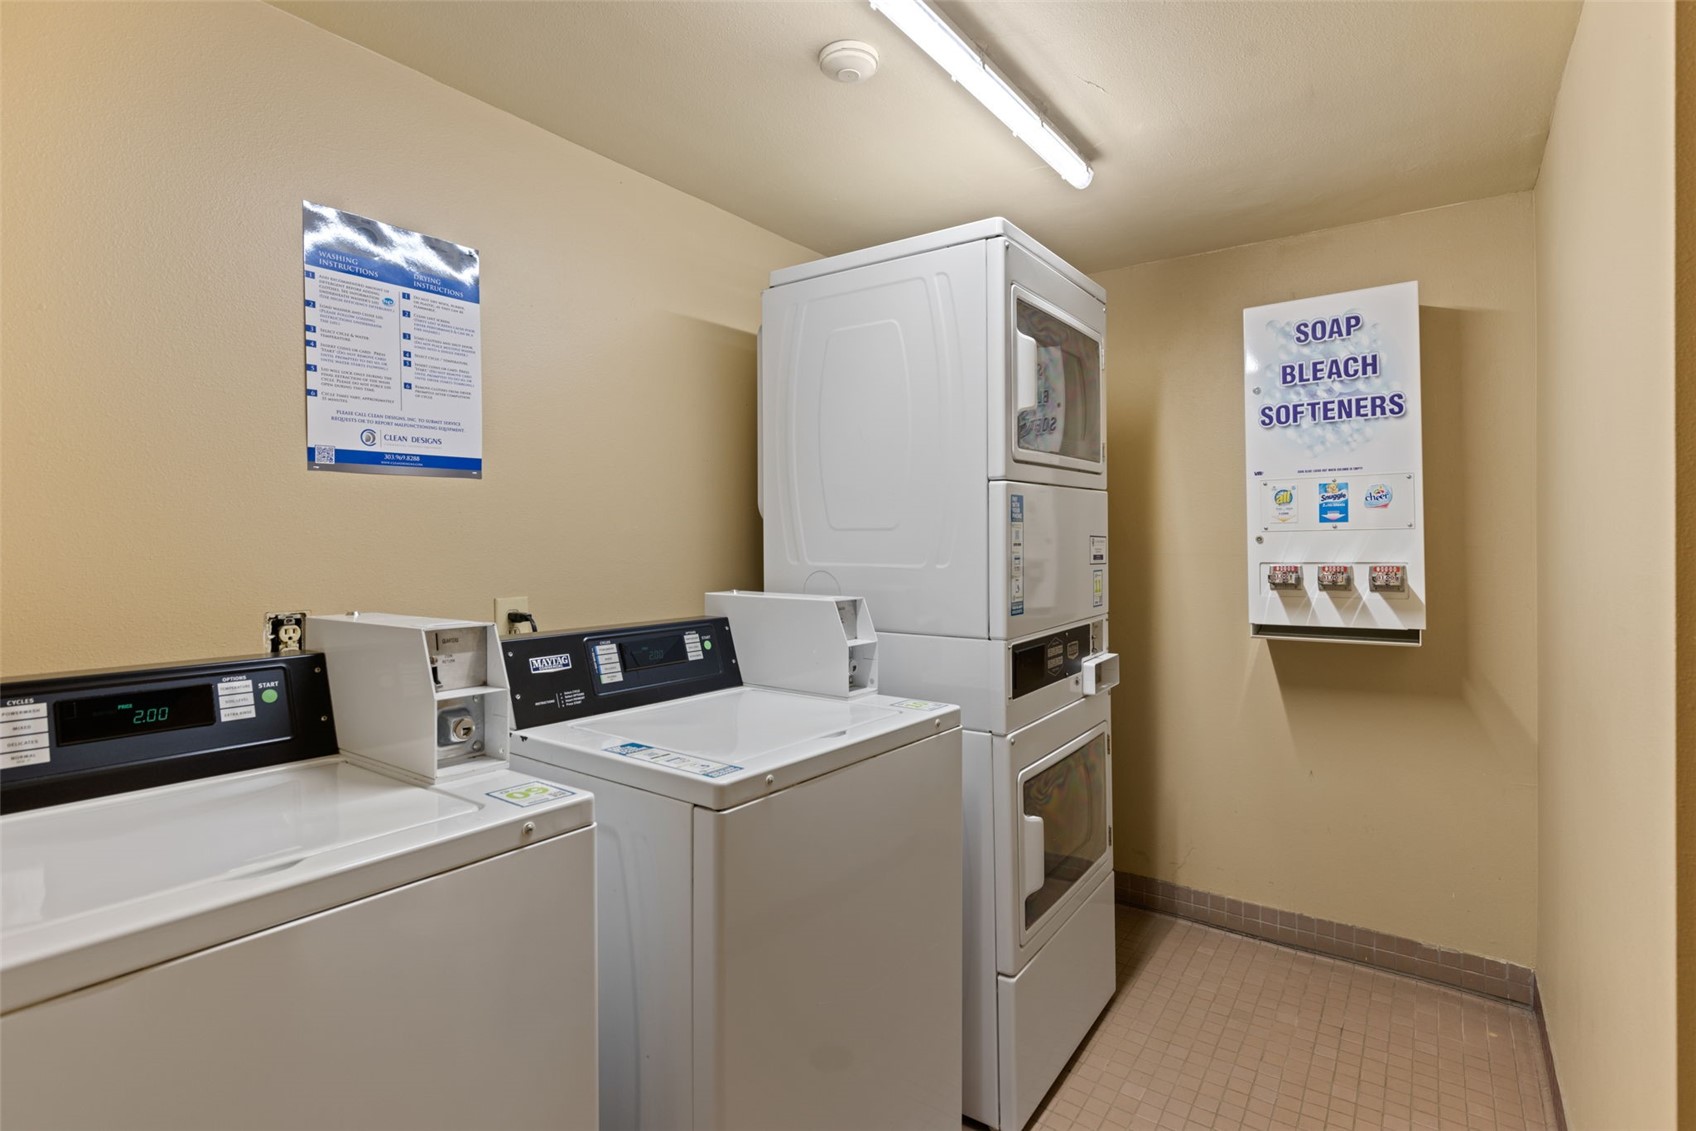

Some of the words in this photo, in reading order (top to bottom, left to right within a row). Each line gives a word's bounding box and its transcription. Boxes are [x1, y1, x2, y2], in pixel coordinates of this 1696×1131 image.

[319, 250, 358, 265] WASHING
[319, 258, 378, 278] INSTRUCTIONS
[413, 273, 440, 285] DRYING
[413, 280, 463, 298] INSTRUCTIONS
[1295, 315, 1361, 343] SOAP
[1281, 354, 1378, 385] BLEACH
[1260, 393, 1404, 426] SOFTENERS
[383, 433, 407, 442] CLEAN
[411, 436, 442, 445] DESIGNS
[384, 453, 420, 461] 303.969.8288
[1275, 490, 1291, 505] all
[1321, 492, 1346, 502] Snuggle
[1365, 492, 1389, 502] cheer
[532, 656, 569, 668] MAYTAG
[258, 680, 279, 689] START
[6, 698, 34, 706] CYCLES
[133, 707, 168, 724] 2.00
[7, 740, 38, 748] DELICATES
